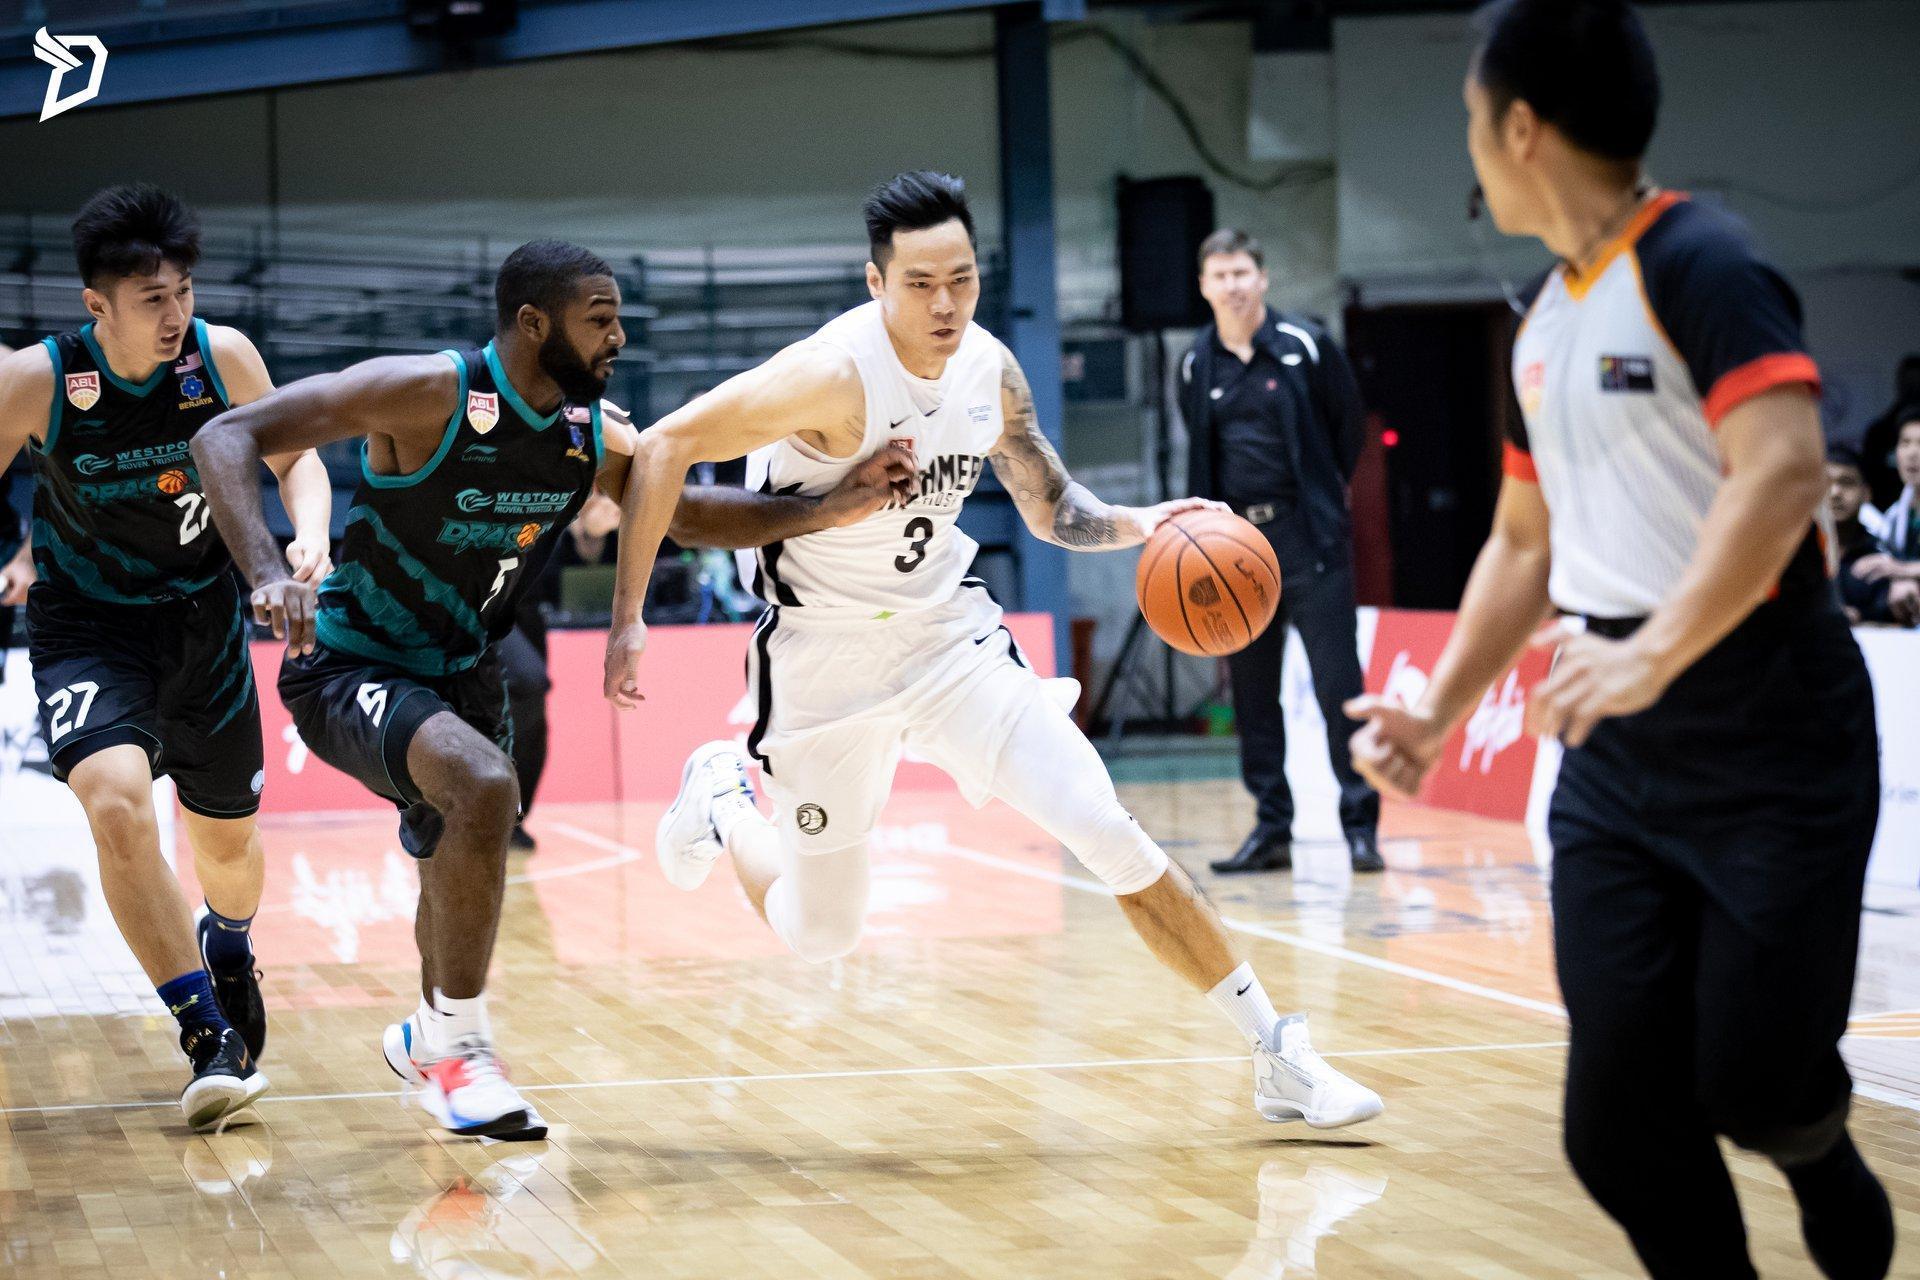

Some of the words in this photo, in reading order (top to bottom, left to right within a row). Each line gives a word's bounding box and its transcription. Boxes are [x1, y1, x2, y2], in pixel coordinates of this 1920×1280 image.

[69, 377, 97, 389] ABL
[178, 396, 214, 411] BERJAYA
[470, 397, 495, 411] ABL
[115, 440, 188, 461] WESTPO
[497, 490, 574, 503] WESTPOR
[895, 516, 934, 573] 3
[46, 680, 99, 744] 27
[356, 682, 388, 727] 5
